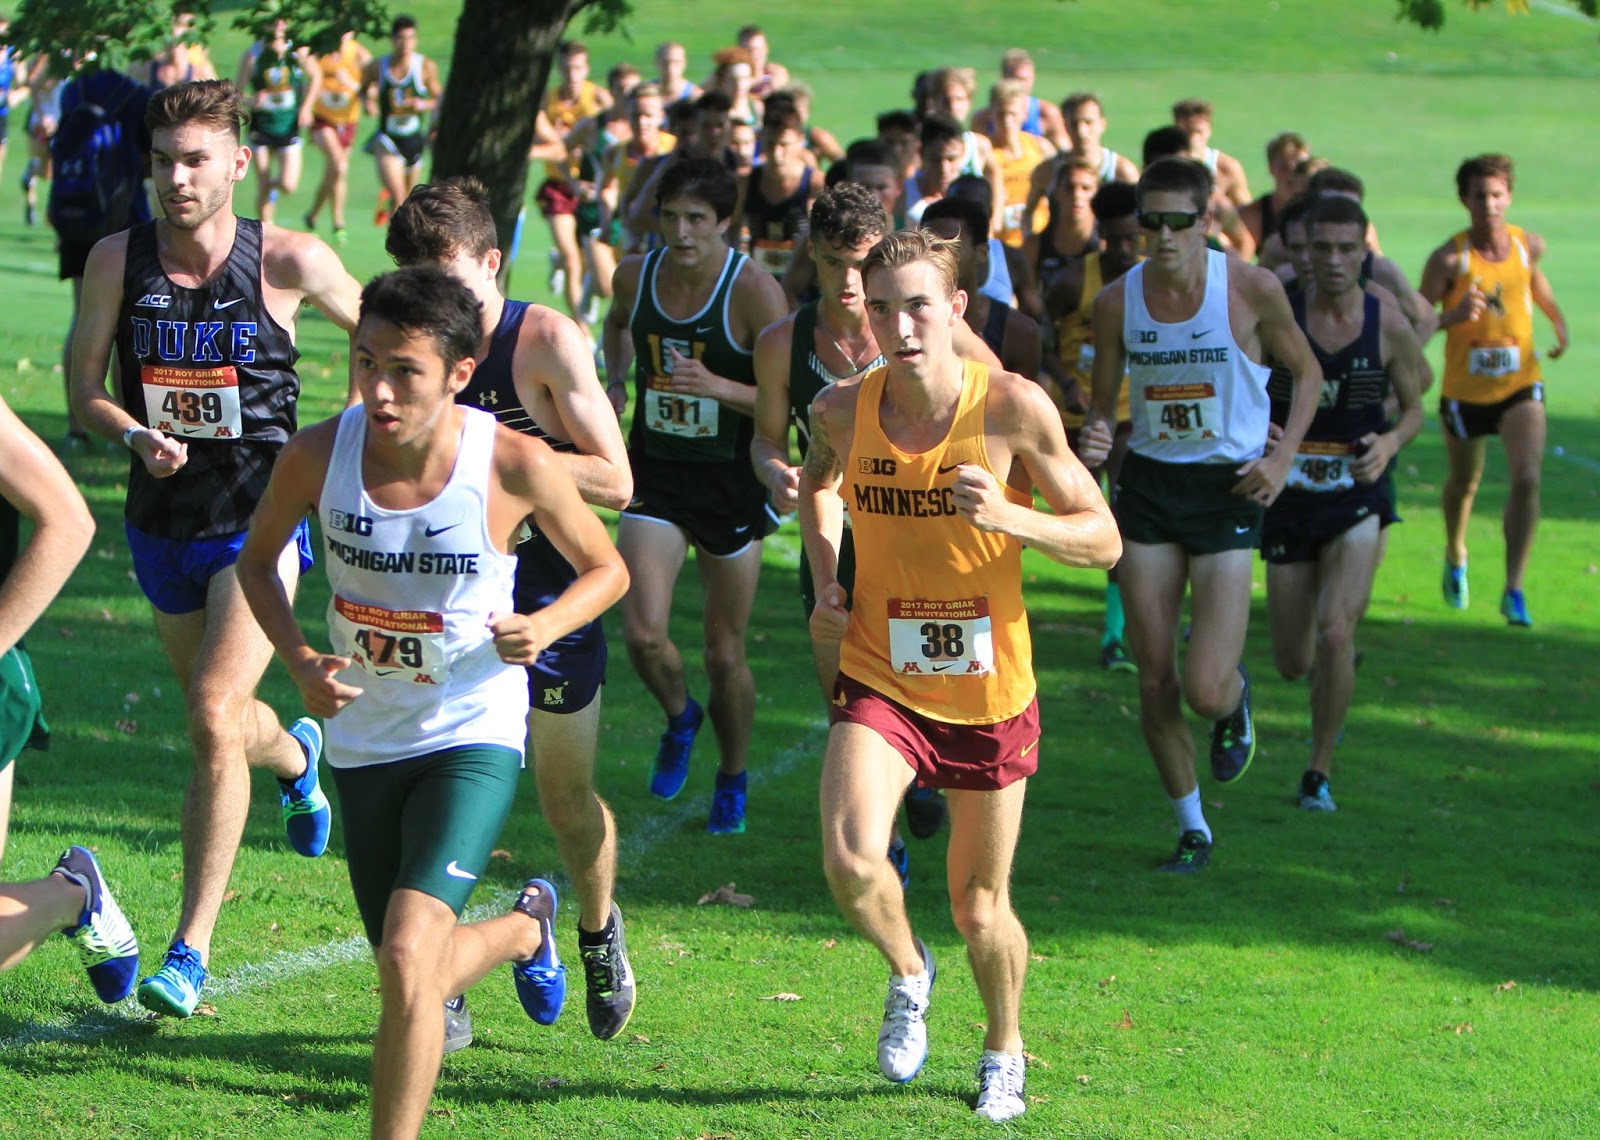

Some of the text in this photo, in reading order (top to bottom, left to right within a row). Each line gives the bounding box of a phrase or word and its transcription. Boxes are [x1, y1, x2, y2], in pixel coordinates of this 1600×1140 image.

[136, 294, 172, 306] ACC
[131, 316, 258, 363] DUKE
[1129, 347, 1229, 366] MICHIGAN STATE
[154, 368, 173, 376] 2017
[196, 369, 224, 377] GRIAK
[166, 378, 227, 386] INVITATIONAL
[162, 391, 223, 424] 439
[658, 395, 700, 425] 511
[1161, 403, 1204, 430] 481
[1300, 457, 1344, 483] 493
[854, 484, 957, 517] MINNESO
[418, 553, 480, 575] STATE
[343, 602, 427, 620] 2017 ROY GRIAK
[914, 610, 978, 618] INVITATIONAL
[945, 600, 975, 610] GRIAK
[358, 614, 430, 630] INVITATIONAL
[355, 629, 422, 668] 479
[921, 623, 964, 658] 38
[544, 687, 564, 701] N
